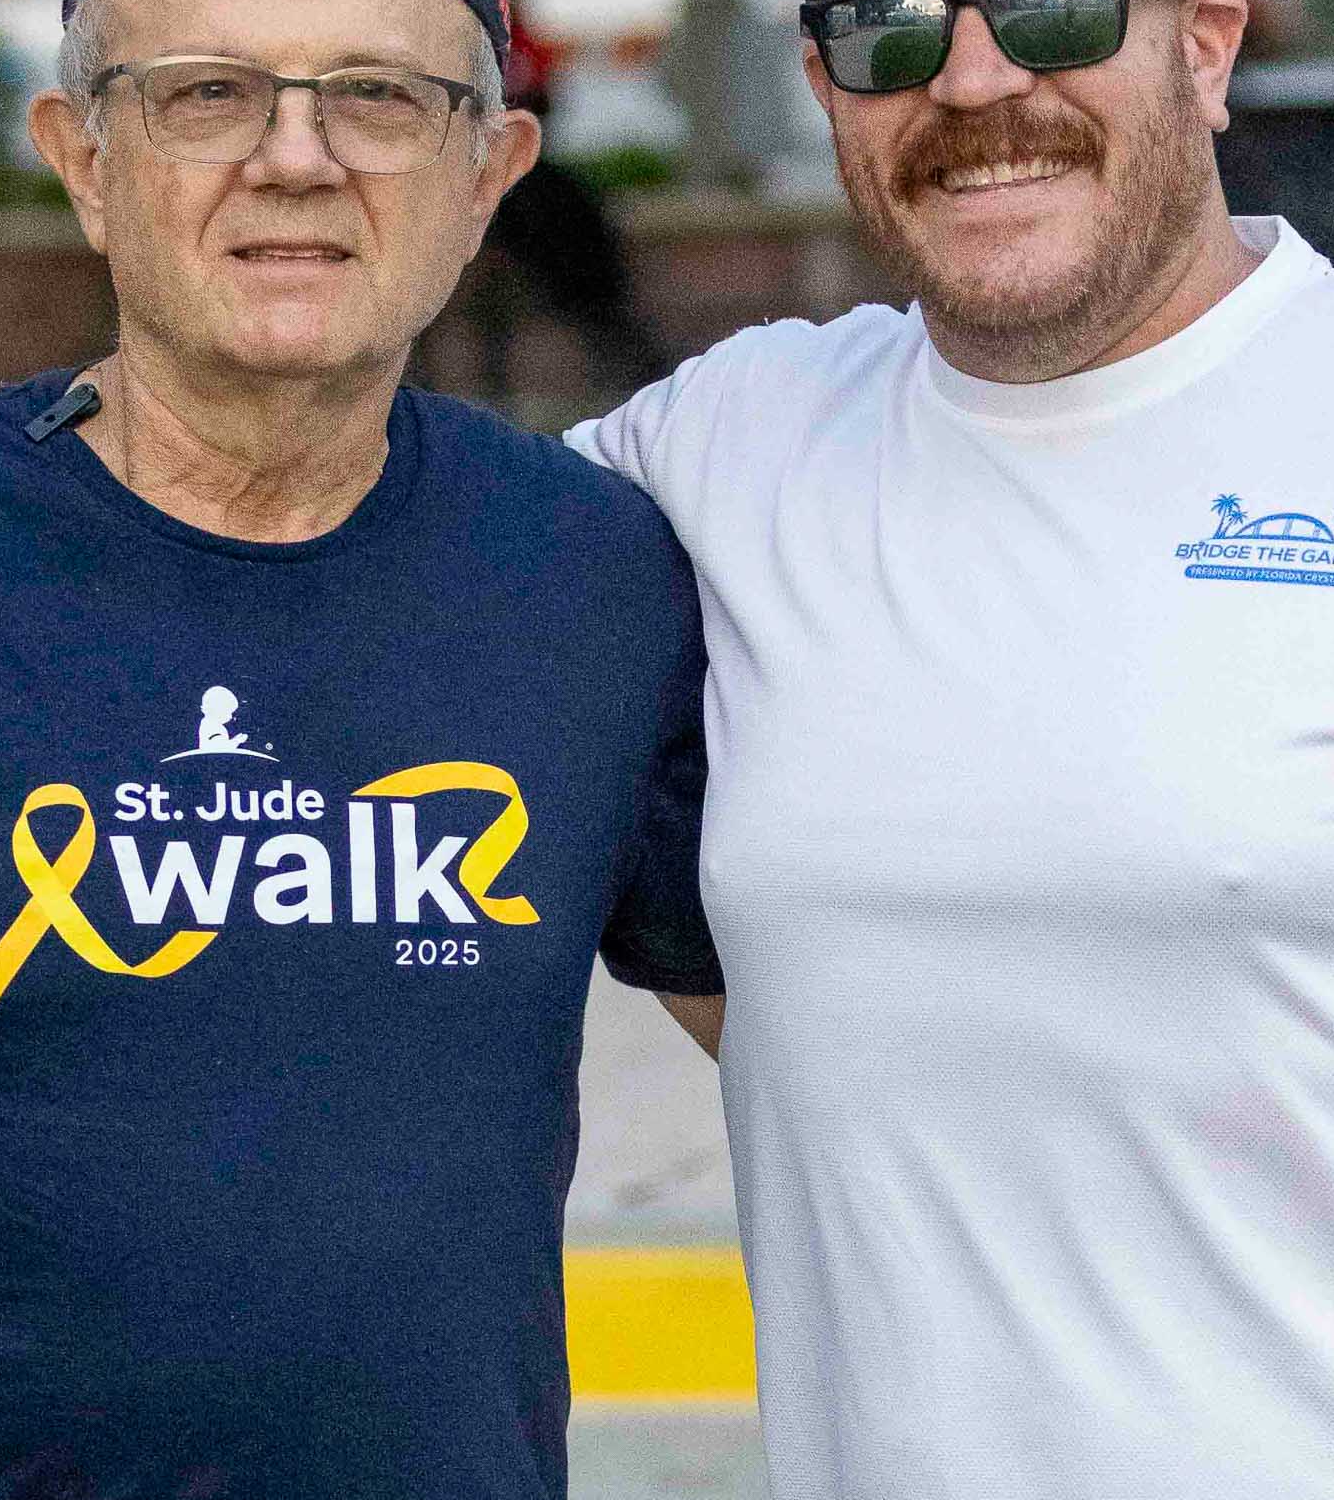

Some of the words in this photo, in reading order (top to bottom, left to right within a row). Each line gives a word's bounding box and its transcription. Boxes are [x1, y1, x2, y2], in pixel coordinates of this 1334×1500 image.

[1174, 541, 1252, 561] BRIDGE
[1257, 546, 1299, 563] THE
[1190, 566, 1243, 579] PRESENTED
[1260, 569, 1302, 581] FLORIDA
[113, 781, 184, 822] St.
[195, 779, 326, 821] Jude
[108, 801, 478, 925] walk
[395, 938, 481, 966] 2025
